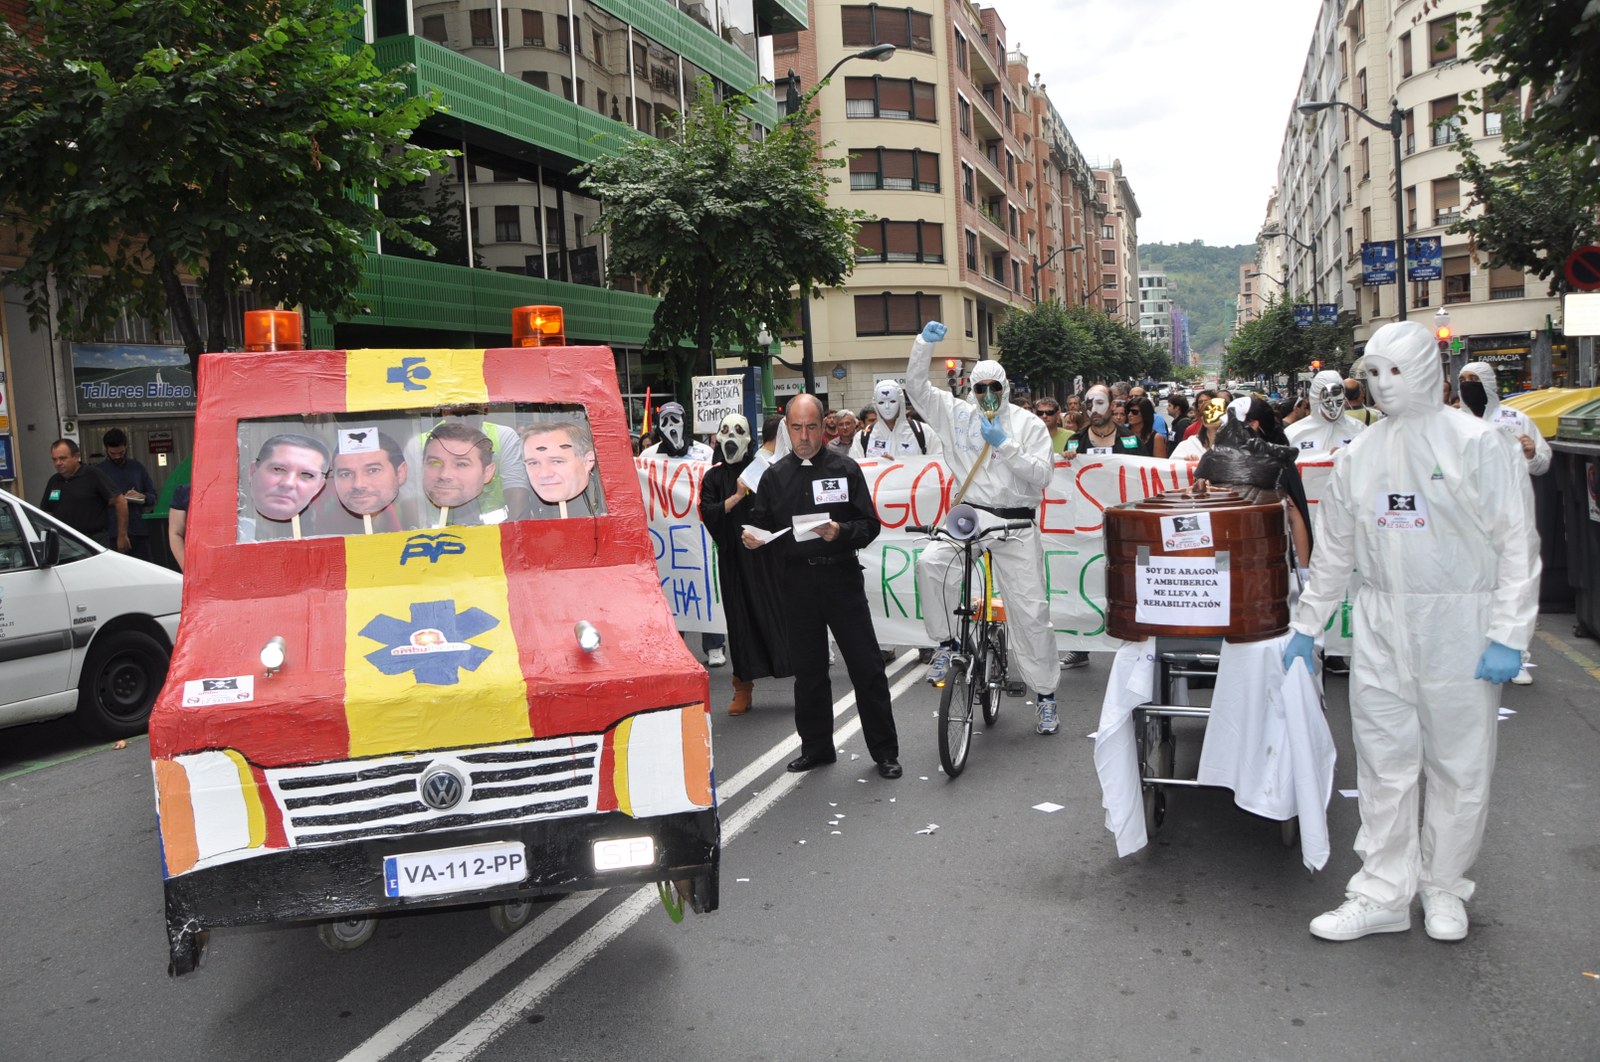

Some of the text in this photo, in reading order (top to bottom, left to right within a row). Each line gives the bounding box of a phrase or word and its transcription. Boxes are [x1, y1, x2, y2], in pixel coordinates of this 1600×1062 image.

[1478, 353, 1521, 362] FARMACIA
[81, 381, 144, 399] Talleres
[146, 381, 192, 398] Bilbao
[1143, 599, 1221, 608] REHABILITACIÓN
[404, 853, 522, 884] VA-112-PP
[390, 879, 398, 889] E
